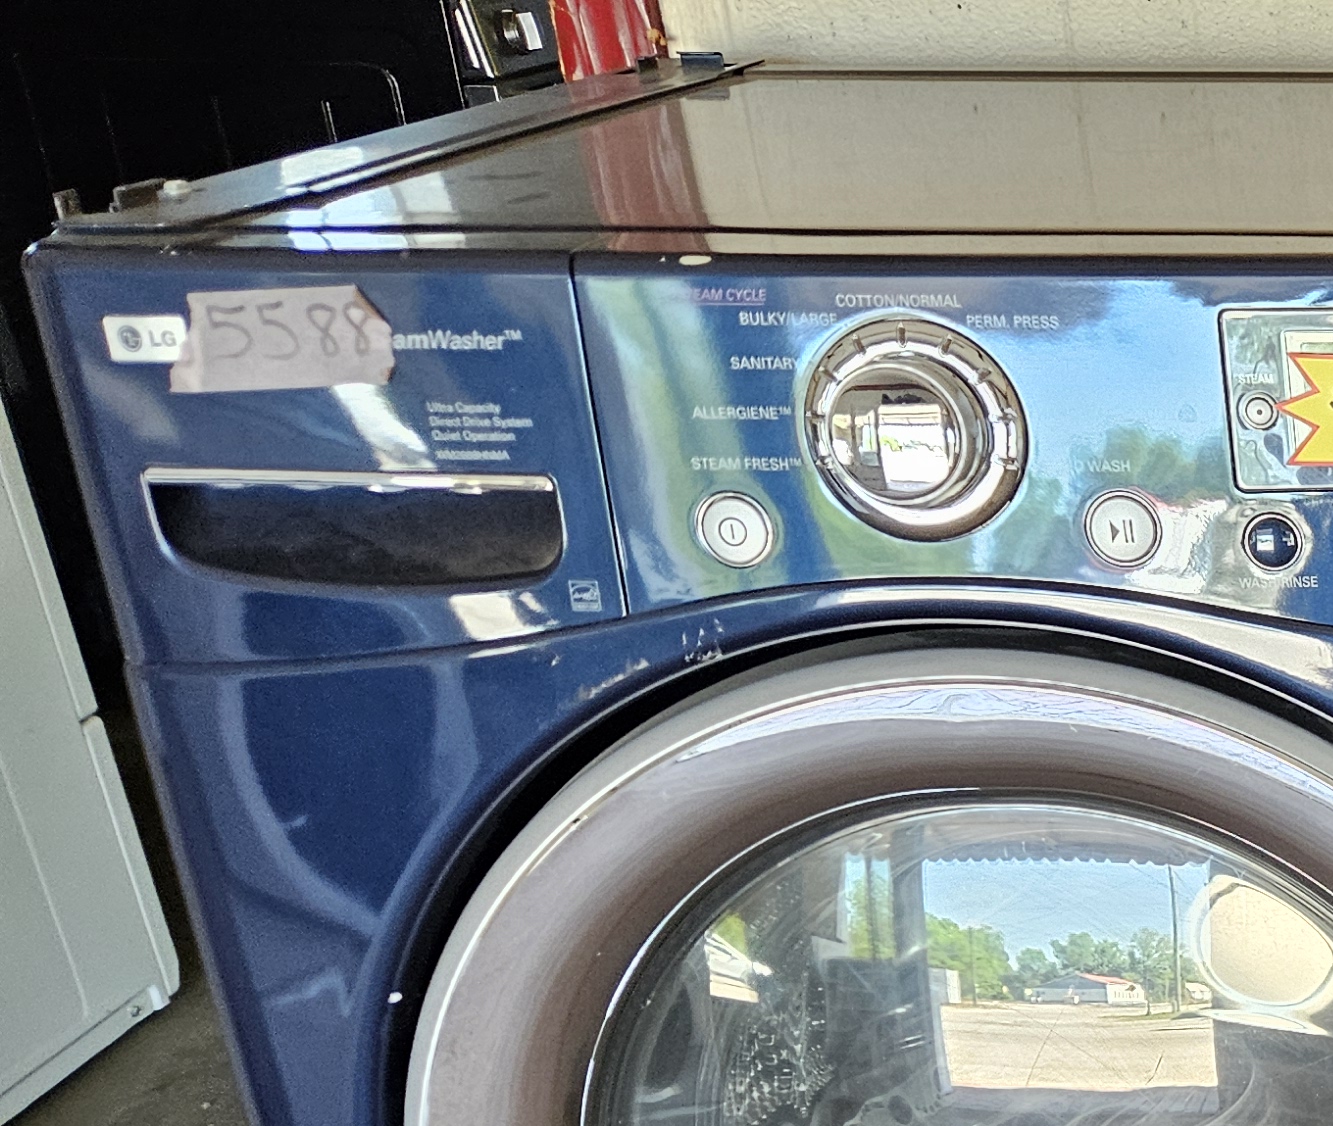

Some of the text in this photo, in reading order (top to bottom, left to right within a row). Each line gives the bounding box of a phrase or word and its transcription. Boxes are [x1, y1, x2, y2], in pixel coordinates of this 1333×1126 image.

[725, 287, 767, 301] CYCLE
[835, 293, 962, 308] COTTON/NORMAL
[738, 310, 837, 327] BULKY/LARGE
[966, 314, 1061, 330] PERM. PRESS
[205, 301, 371, 360] 5588
[148, 330, 177, 348] LG
[730, 356, 801, 371] SANITARY
[1238, 373, 1274, 385] STEAM
[690, 456, 742, 471] STEAM
[1086, 459, 1131, 473] WASH
